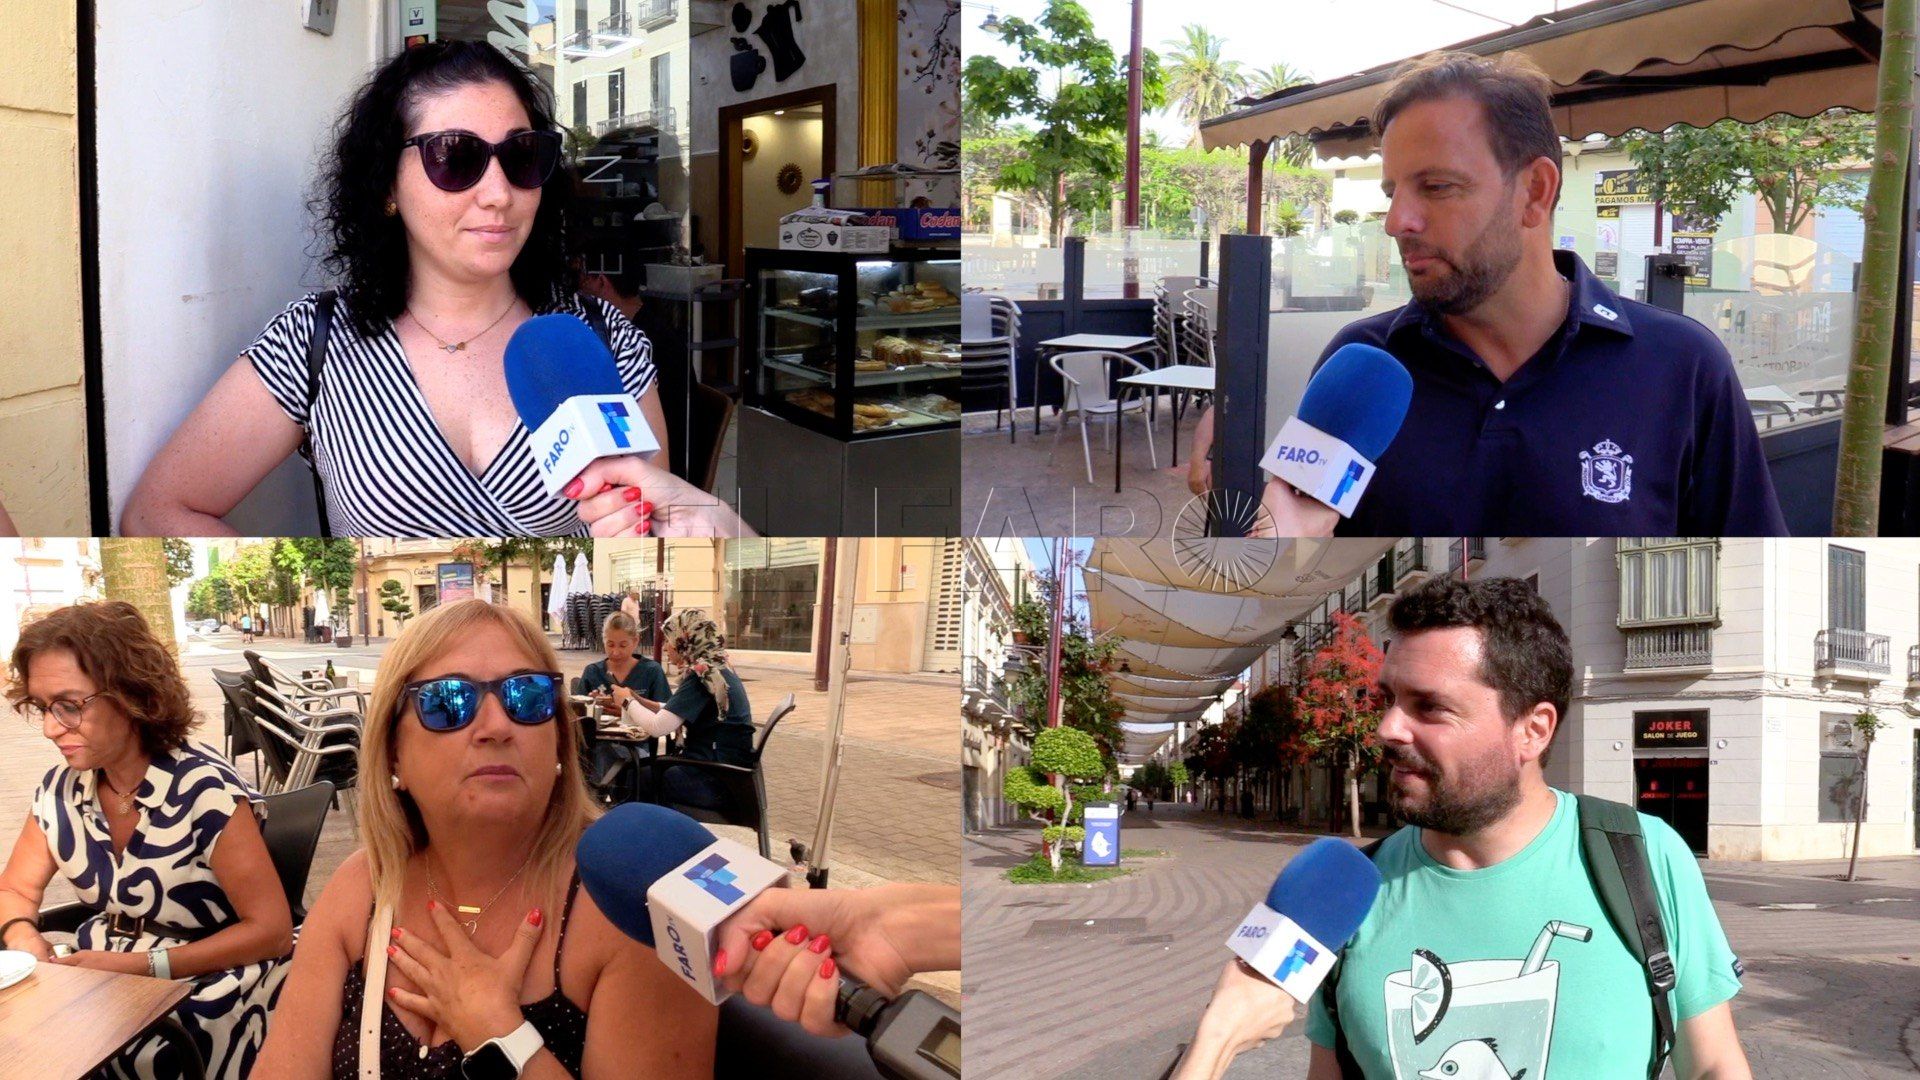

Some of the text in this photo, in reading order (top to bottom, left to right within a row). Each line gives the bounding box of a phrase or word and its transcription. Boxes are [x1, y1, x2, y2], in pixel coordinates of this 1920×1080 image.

[1594, 195, 1635, 205] PAGAMOS
[543, 429, 569, 474] FARO
[1276, 445, 1320, 464] FARO
[1649, 720, 1692, 731] JOKER
[1237, 925, 1267, 938] FARO
[666, 925, 696, 982] FARO
